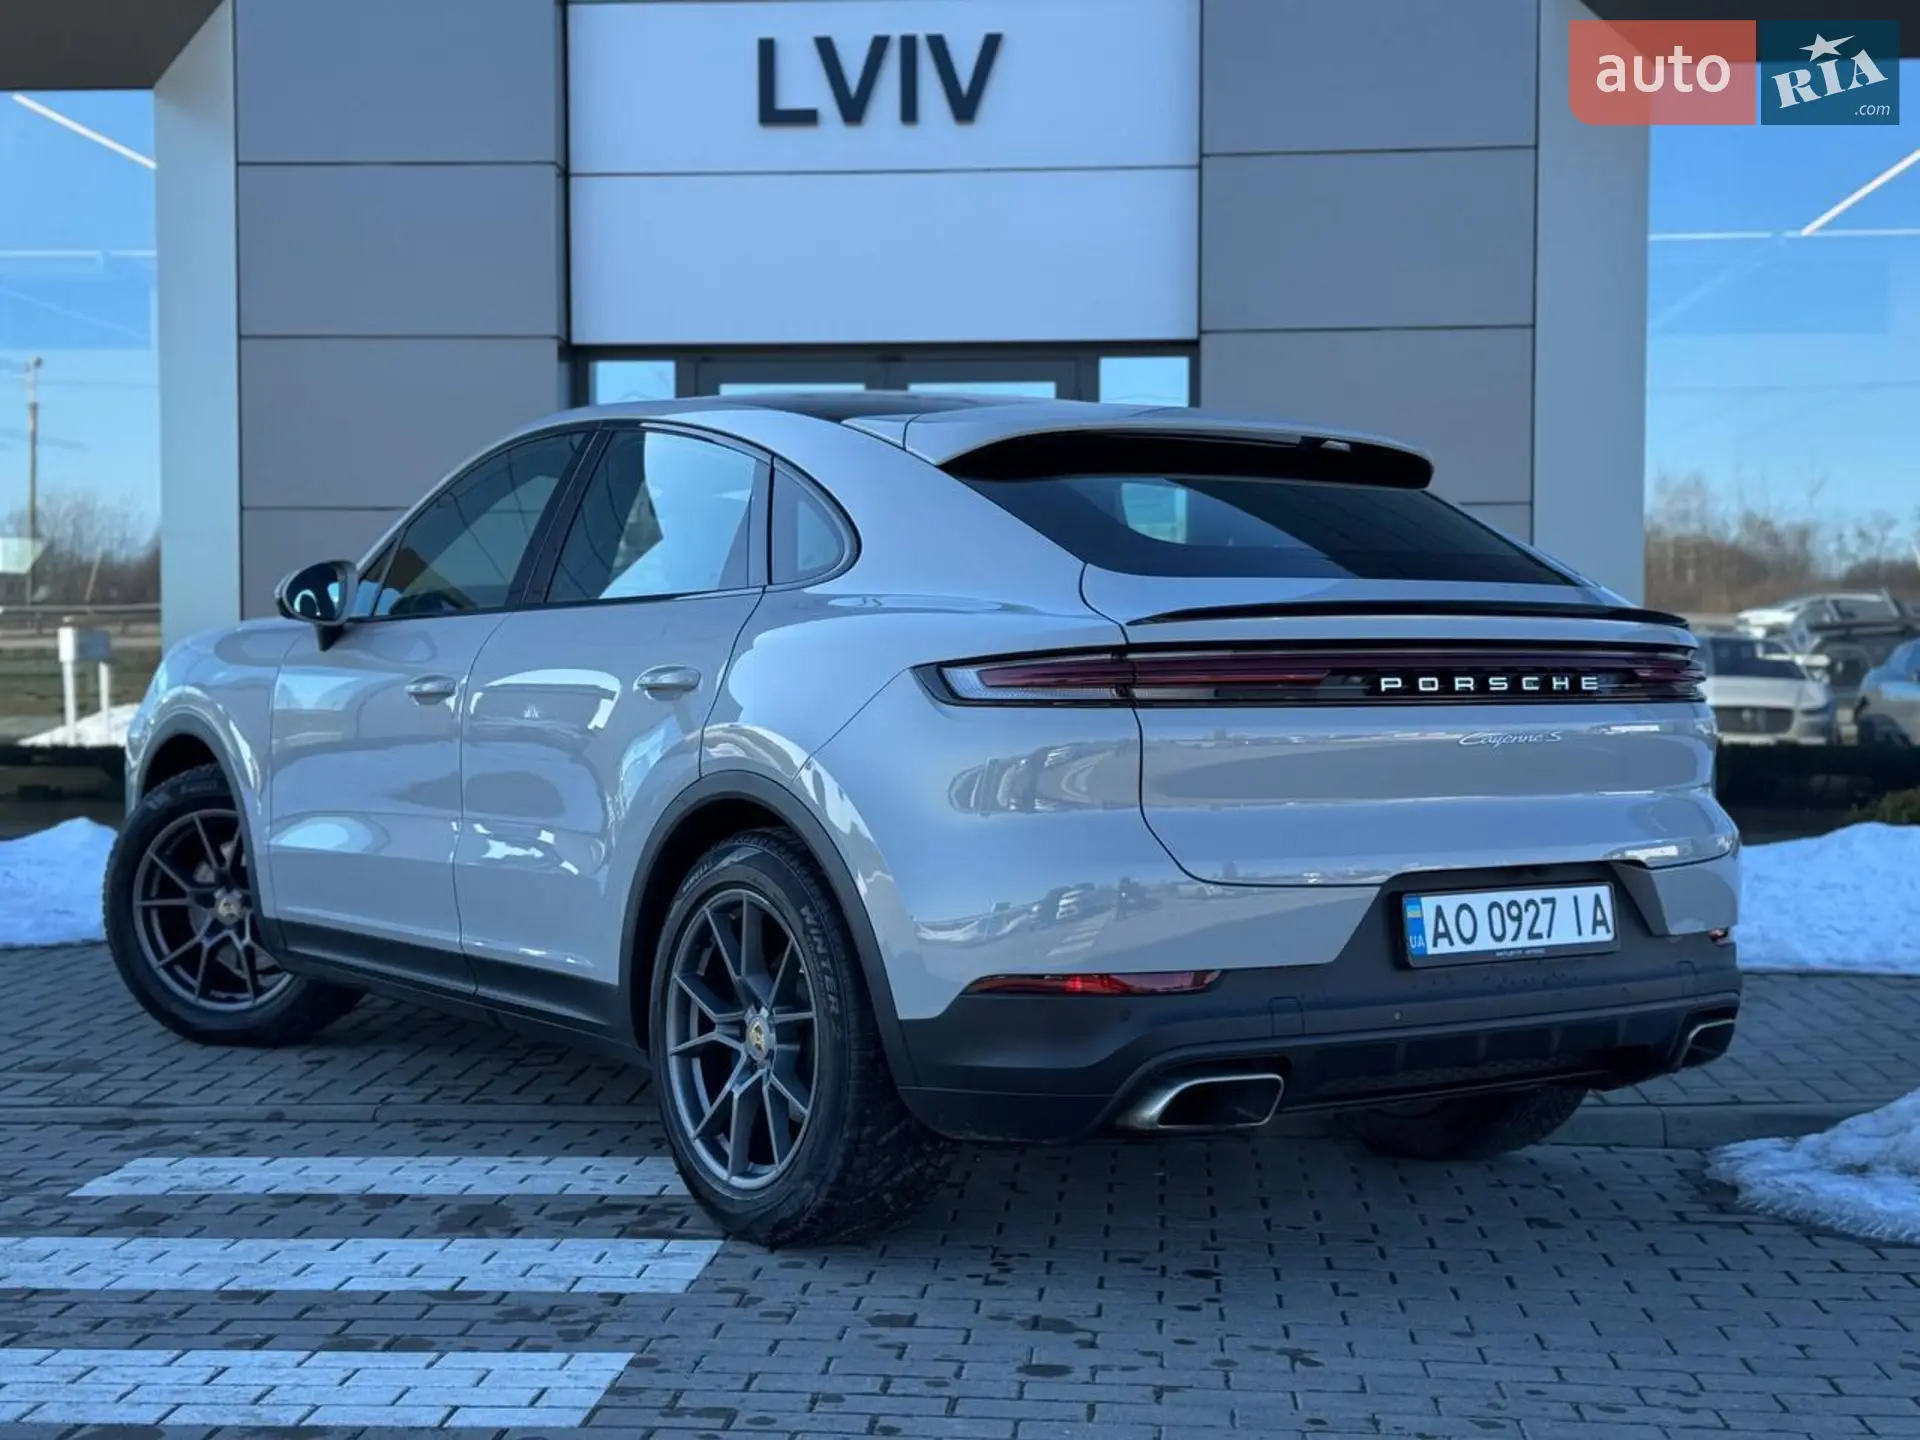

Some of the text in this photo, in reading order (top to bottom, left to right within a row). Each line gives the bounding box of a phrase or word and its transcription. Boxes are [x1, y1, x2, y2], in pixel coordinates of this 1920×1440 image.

[757, 33, 1003, 127] LVIV
[1380, 676, 1599, 692] PORSCHE
[1458, 730, 1562, 748] Cayenne S
[1432, 893, 1611, 948] AO 0927 IA
[1409, 935, 1425, 949] UA
